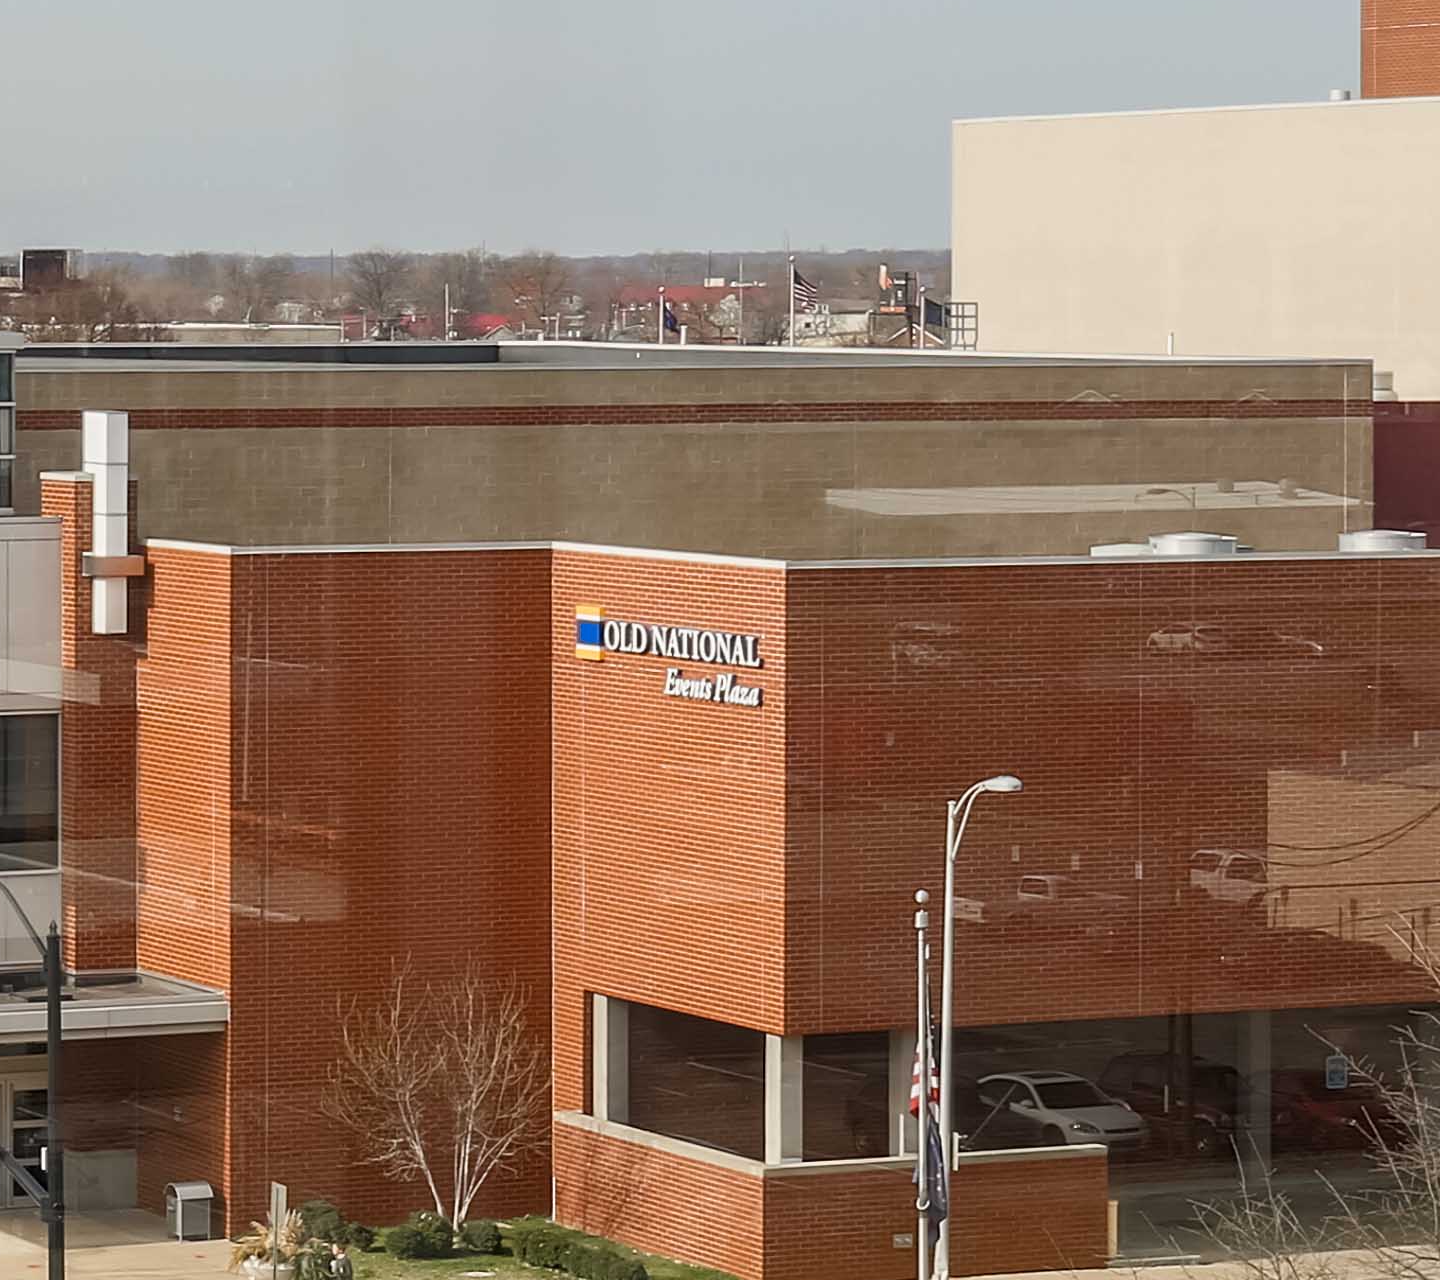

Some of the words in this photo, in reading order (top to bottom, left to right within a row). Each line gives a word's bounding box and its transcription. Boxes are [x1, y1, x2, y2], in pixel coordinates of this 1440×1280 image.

[604, 621, 647, 654] OLD
[652, 625, 760, 667] NATIONAL
[664, 667, 712, 701] Events
[714, 673, 760, 707] Plaza
